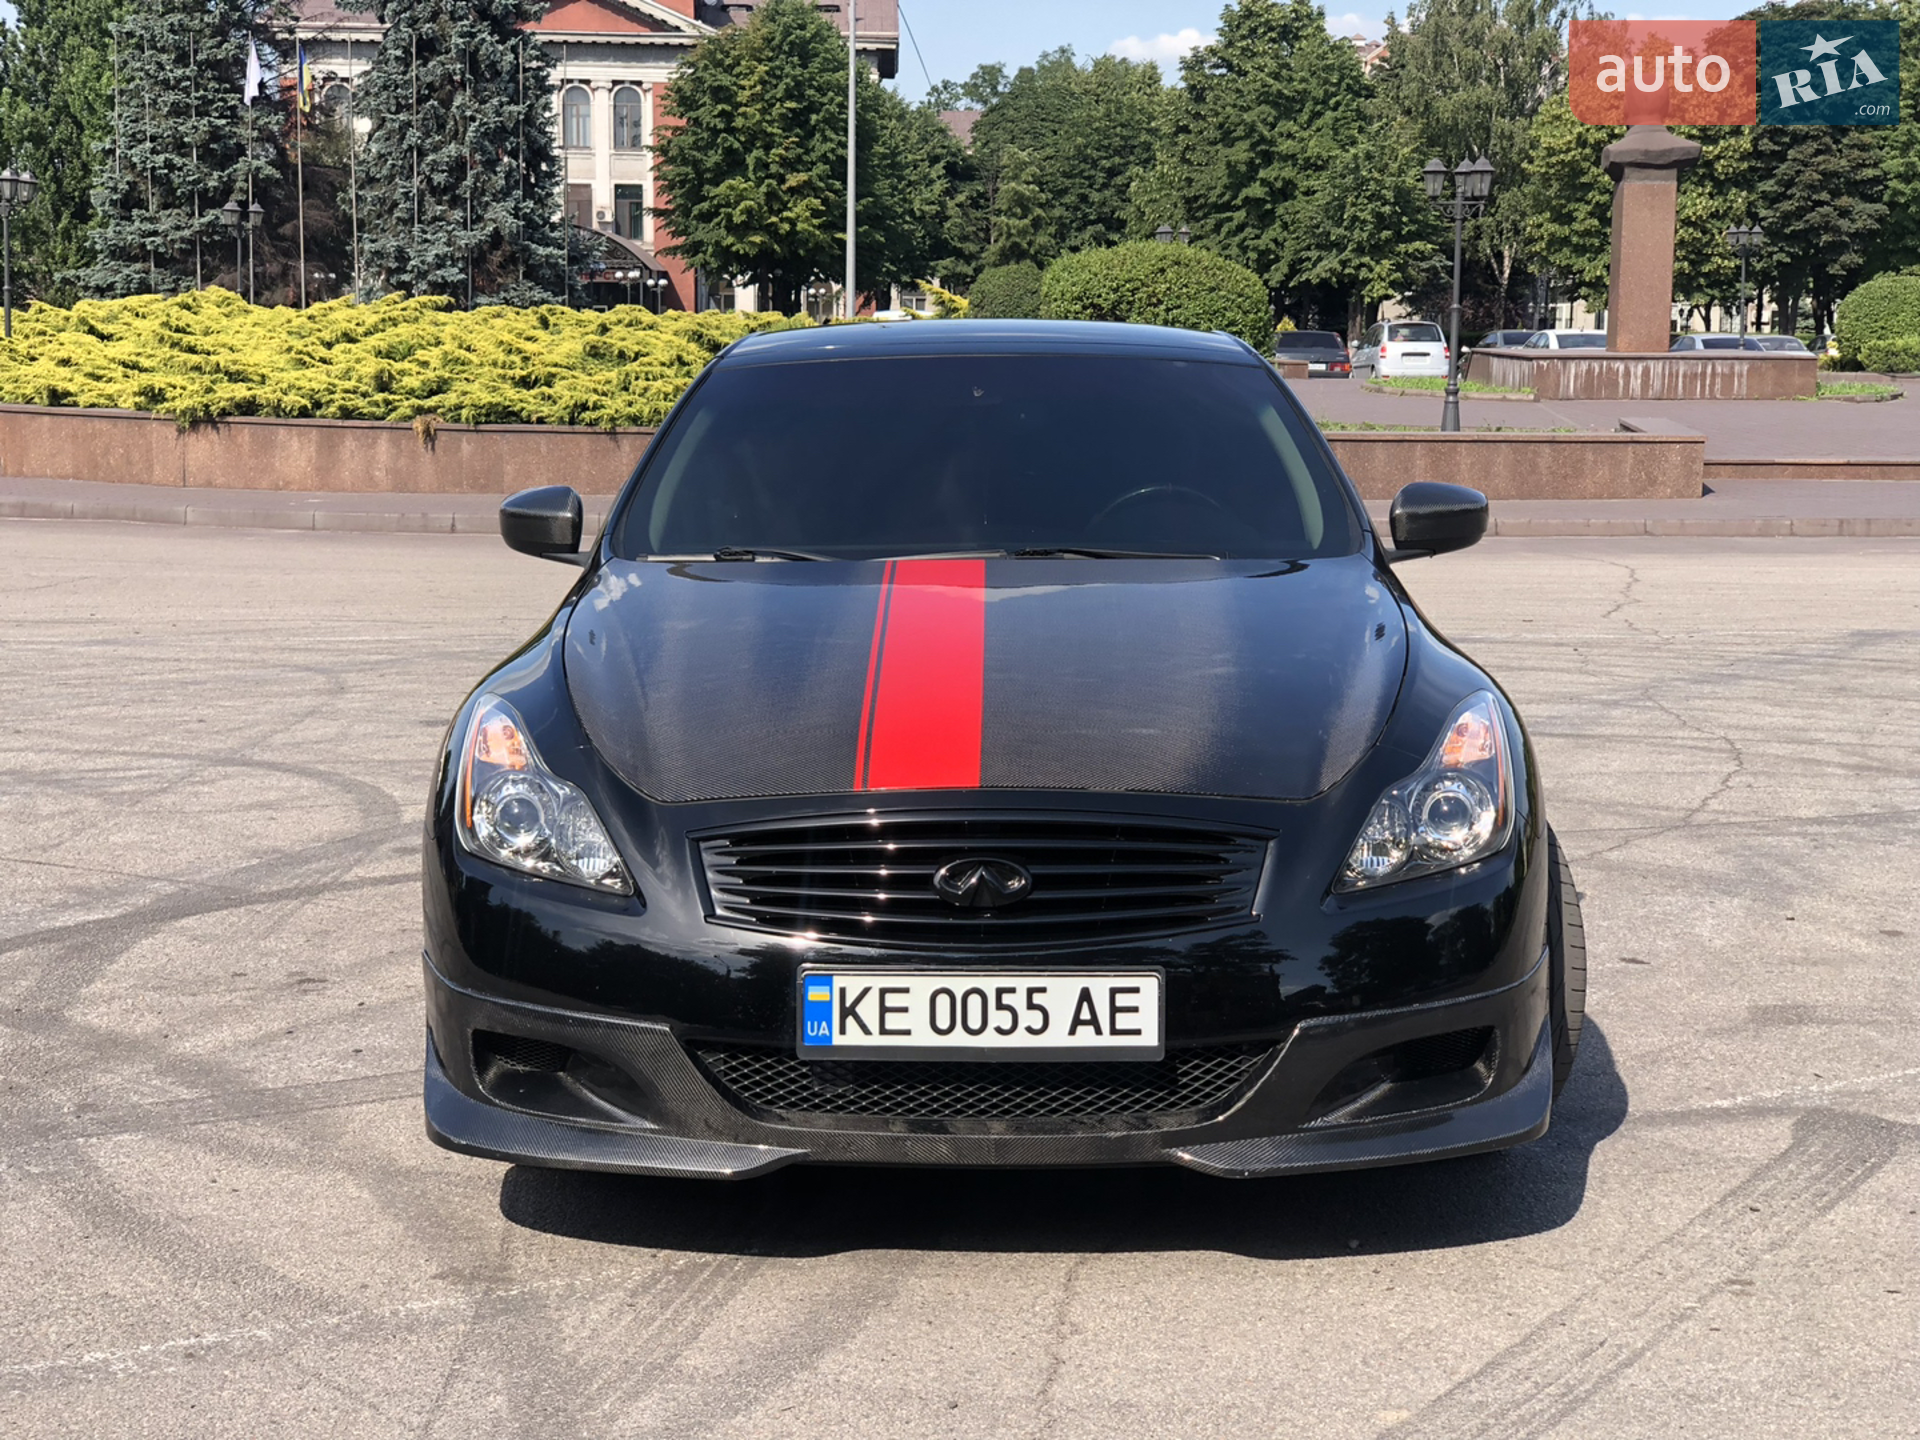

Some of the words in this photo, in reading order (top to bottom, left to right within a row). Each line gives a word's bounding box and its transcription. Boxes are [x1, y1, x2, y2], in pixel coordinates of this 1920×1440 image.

[838, 986, 912, 1036] KE
[928, 986, 1050, 1036] 0055
[1067, 986, 1143, 1036] AE
[807, 1020, 831, 1037] UA
